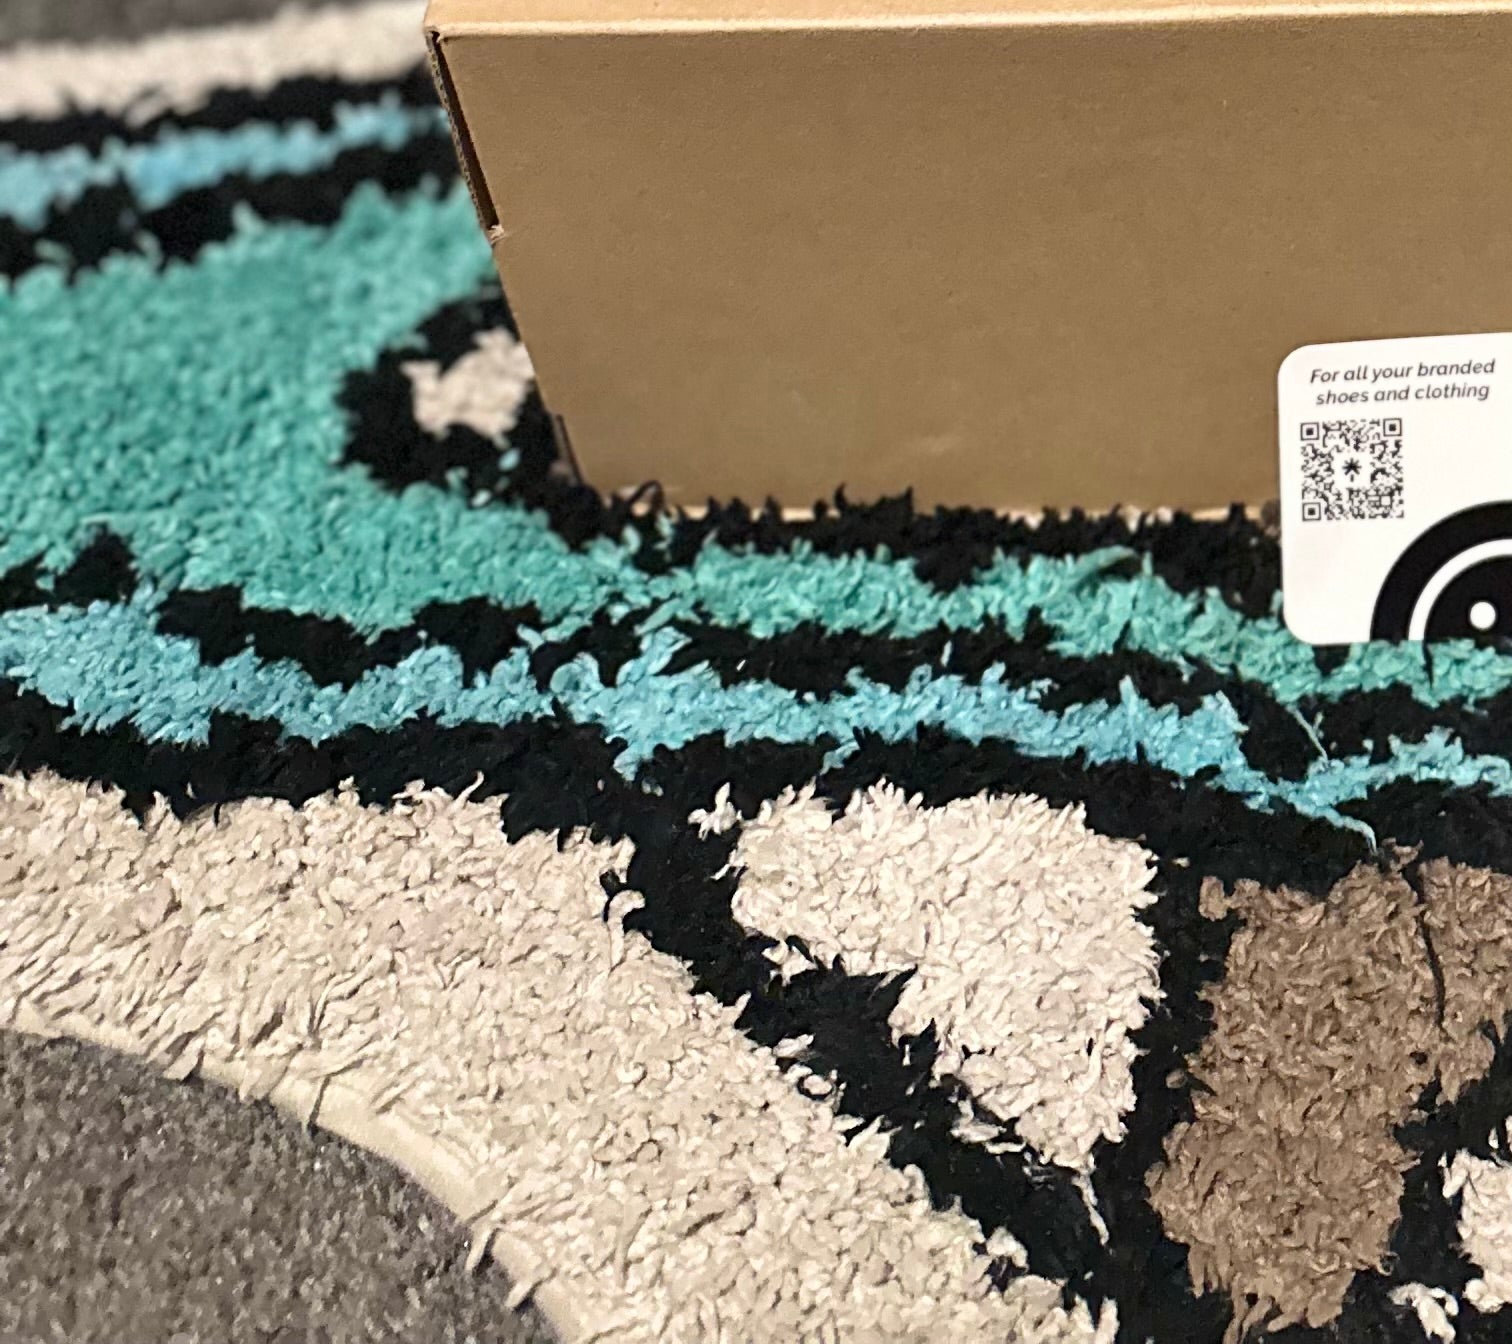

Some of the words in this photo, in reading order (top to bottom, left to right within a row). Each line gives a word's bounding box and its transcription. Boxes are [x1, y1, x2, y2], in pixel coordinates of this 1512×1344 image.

[1310, 368, 1341, 384] For
[1343, 364, 1368, 381] all
[1371, 365, 1413, 383] your
[1417, 358, 1495, 377] branded
[1316, 389, 1369, 405] shoes
[1374, 385, 1410, 401] and
[1415, 382, 1490, 401] clothing
